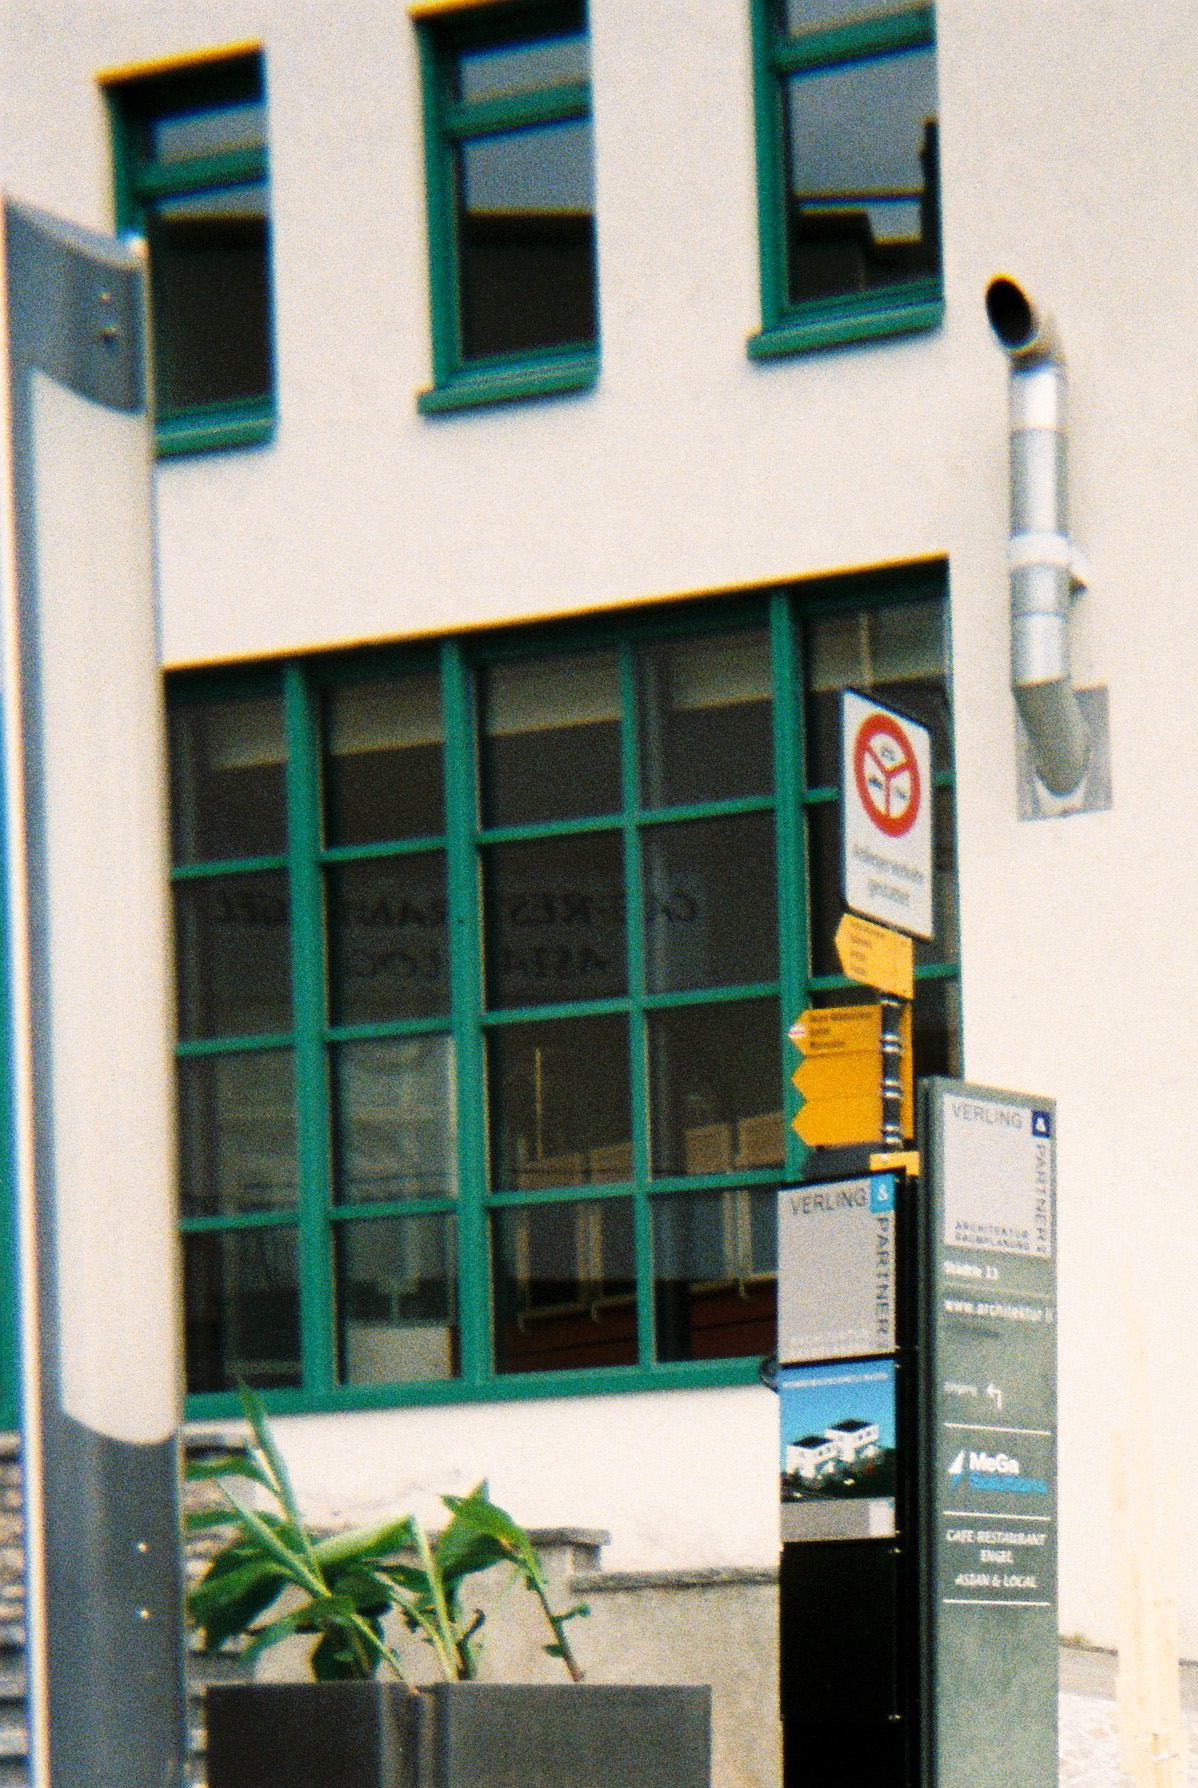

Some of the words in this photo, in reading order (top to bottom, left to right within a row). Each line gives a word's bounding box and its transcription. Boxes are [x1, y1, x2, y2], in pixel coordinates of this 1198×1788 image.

[952, 1103, 1023, 1130] VERLING
[790, 1187, 867, 1215] VERLING
[877, 1182, 889, 1202] &
[954, 1220, 1030, 1239] ARCHITEKTUR
[968, 1451, 1020, 1475] MeGa
[976, 1530, 1049, 1547] RESTAURANT
[1002, 1573, 1038, 1588] LOCAL
